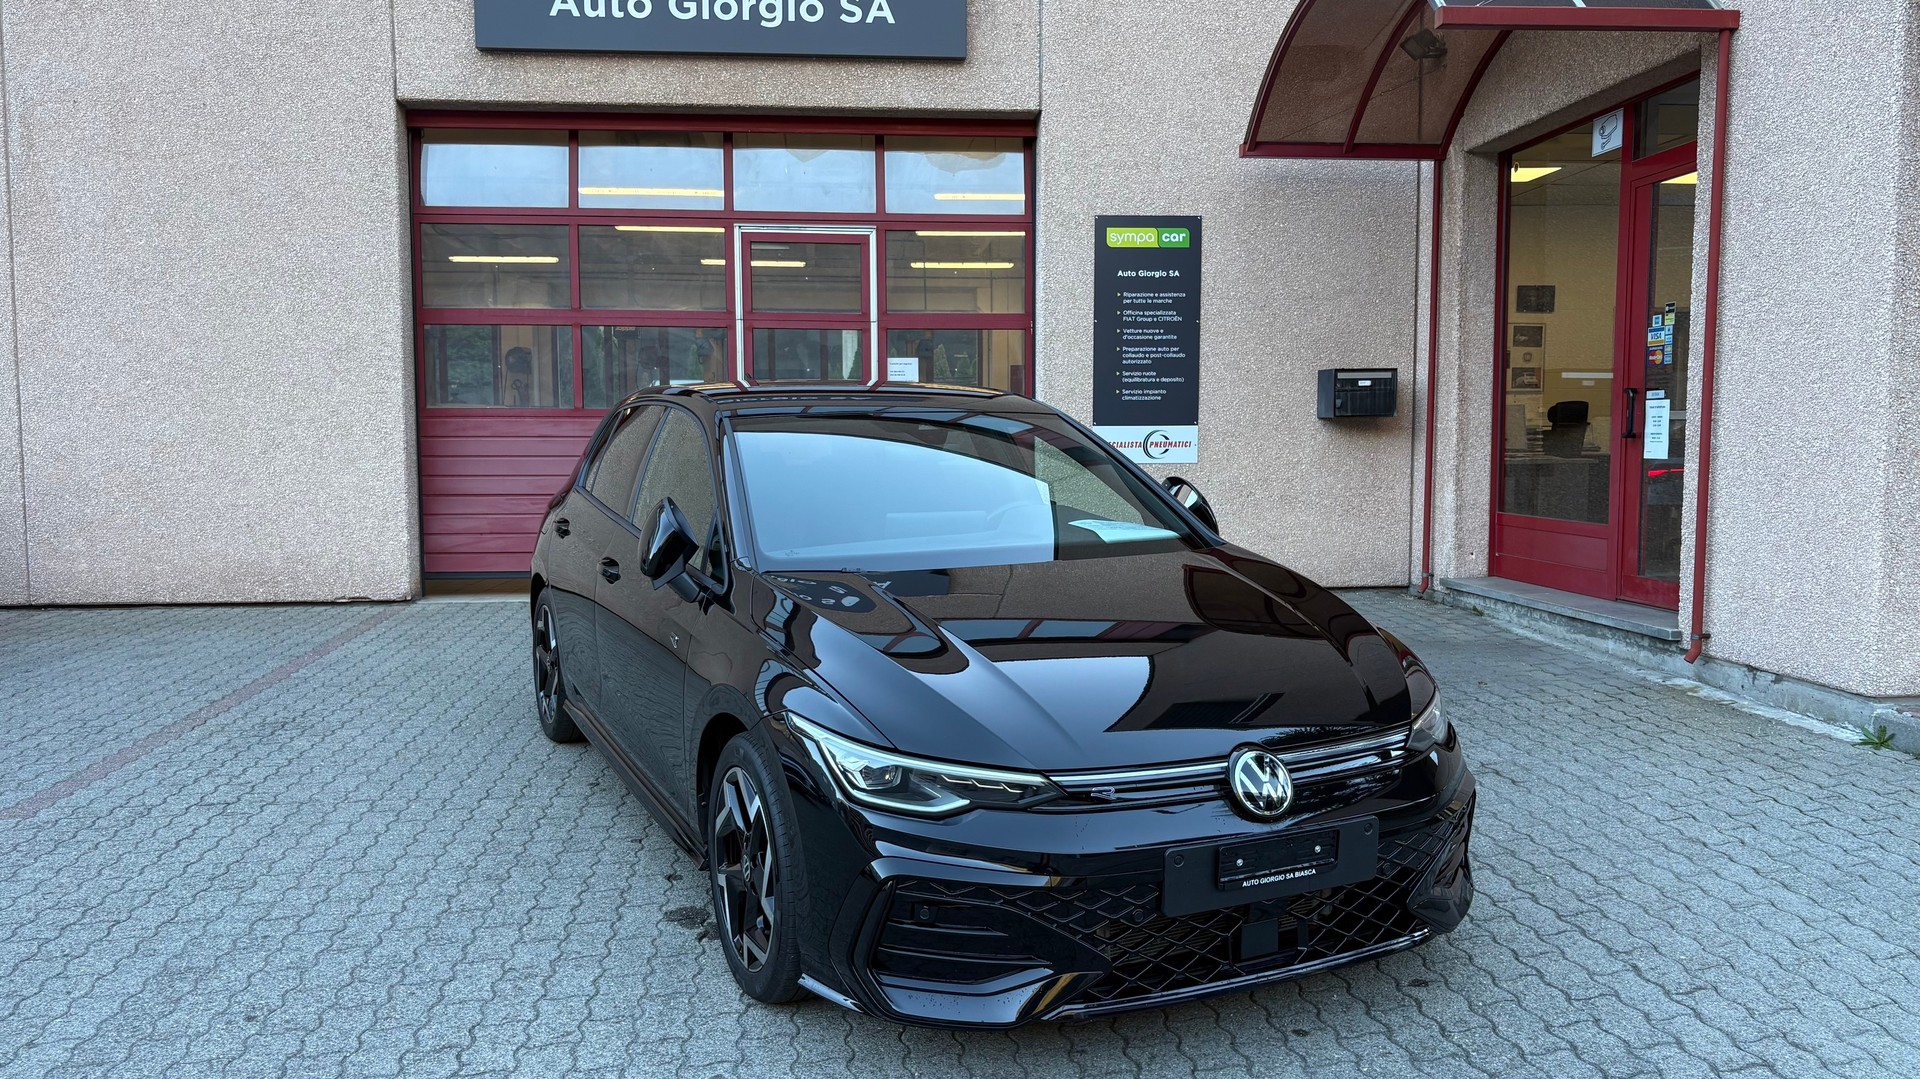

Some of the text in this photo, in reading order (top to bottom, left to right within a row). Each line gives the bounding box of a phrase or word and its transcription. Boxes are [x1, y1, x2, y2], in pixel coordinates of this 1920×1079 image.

[549, 0, 896, 28] Auto Giorgio SA
[1110, 232, 1186, 245] sympa car
[1138, 270, 1167, 278] Giorgio
[1149, 440, 1192, 448] PNEUMATICI
[1242, 879, 1259, 887] AUTO
[1260, 875, 1285, 884] GIORGIO
[1295, 869, 1316, 878] BIASCA
